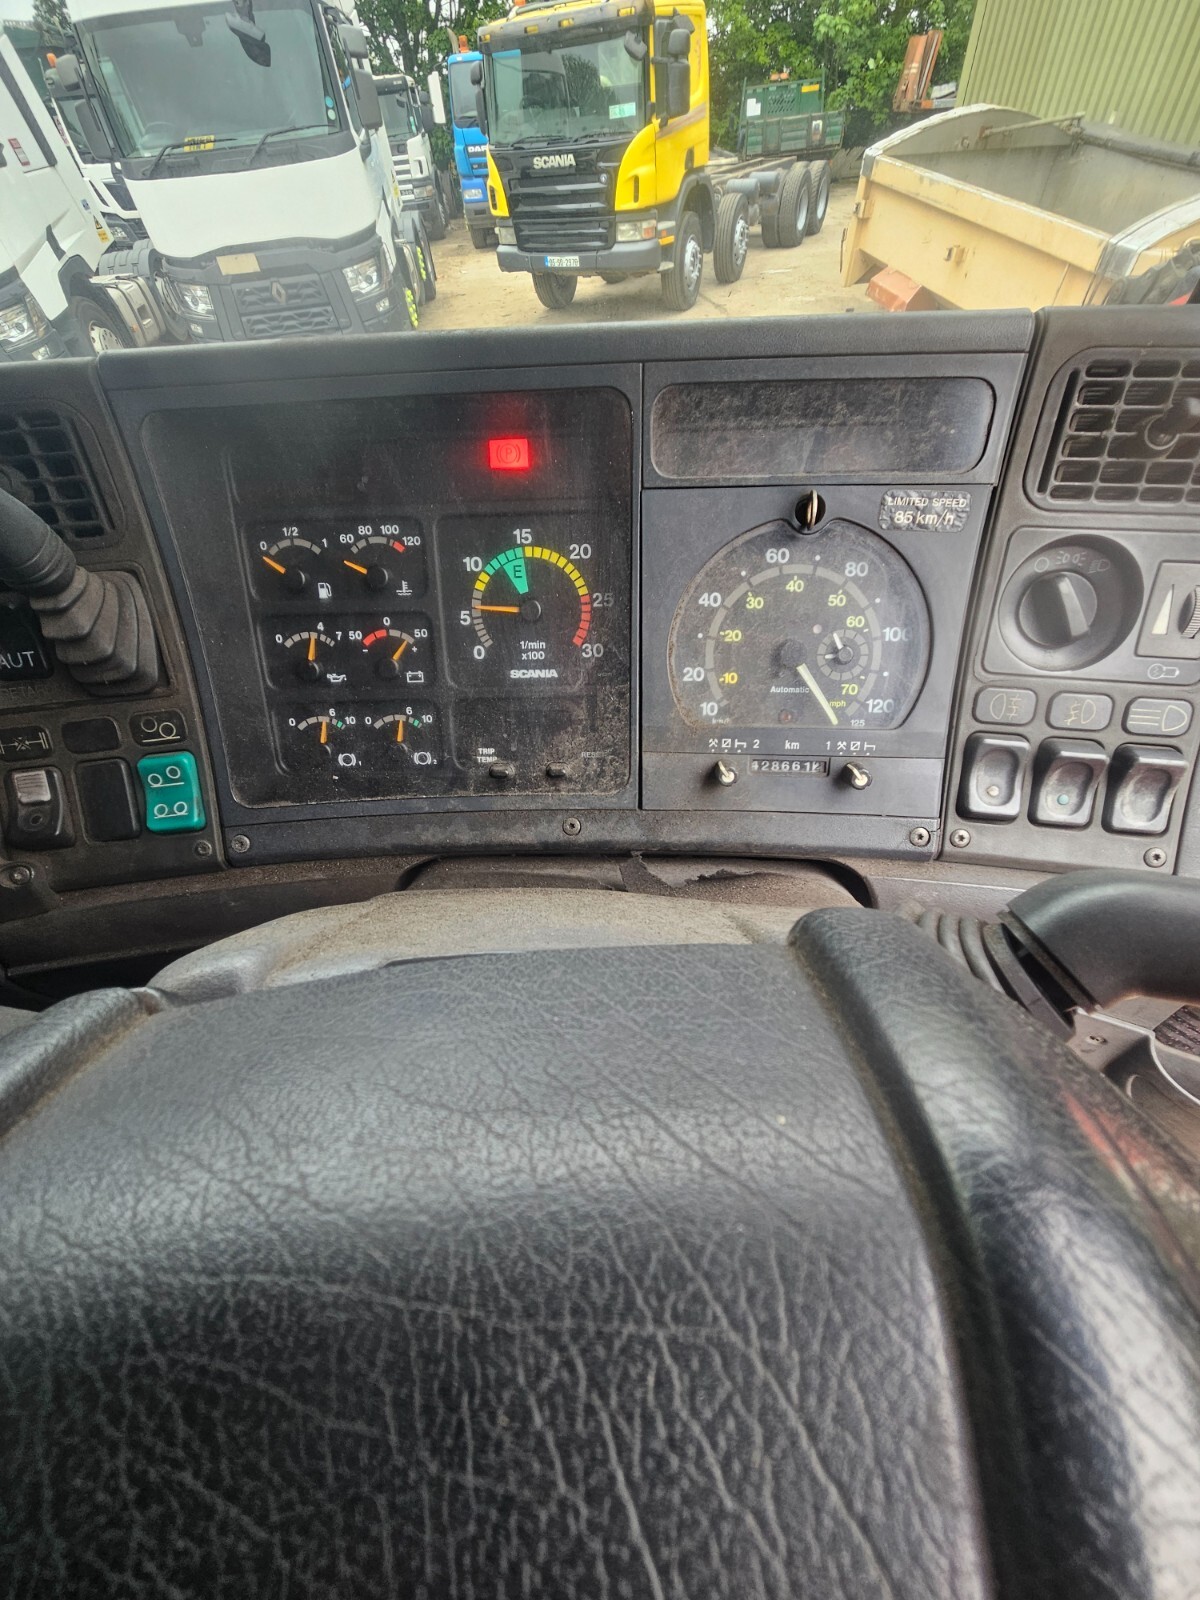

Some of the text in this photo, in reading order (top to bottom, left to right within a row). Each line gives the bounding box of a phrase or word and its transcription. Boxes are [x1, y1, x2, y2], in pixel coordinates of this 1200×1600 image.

[533, 153, 576, 169] SCANIA
[887, 497, 967, 508] LIMITED SPEED
[915, 509, 954, 527] km/h
[282, 526, 299, 537] 1/2
[358, 525, 372, 535] 80
[380, 524, 399, 535] 100
[339, 534, 354, 544] 60
[402, 536, 421, 546] 120
[513, 529, 532, 544] 15
[259, 541, 267, 551] 0
[322, 538, 328, 548] 1
[569, 544, 592, 559] 20
[766, 548, 790, 563] 60
[463, 557, 482, 572] 10
[845, 562, 868, 577] 80
[513, 565, 522, 579] E
[786, 580, 804, 592] 40
[592, 593, 614, 608] 25
[698, 592, 721, 607] 40
[746, 597, 764, 609] 30
[828, 594, 846, 607] 50
[383, 617, 391, 626] 0
[460, 611, 471, 626] 5
[846, 616, 865, 628] 60
[317, 622, 324, 631] 4
[276, 634, 283, 643] 0
[335, 632, 342, 641] 7
[349, 631, 362, 640] 50
[414, 628, 428, 638] 50
[723, 629, 742, 642] 20
[882, 627, 909, 642] 100
[520, 640, 546, 650] 1/min
[582, 643, 604, 658] 30
[473, 646, 485, 660] 0
[521, 651, 545, 661] x100
[0, 651, 35, 671] AUT
[510, 669, 558, 679] SCANIA
[683, 667, 705, 682] 20
[723, 672, 738, 684] 10
[770, 685, 810, 694] Automatic
[841, 683, 858, 696] 70
[700, 702, 718, 716] 10
[830, 700, 846, 709] mph
[866, 698, 893, 713] 120
[329, 708, 336, 717] 6
[406, 706, 413, 715] 6
[289, 717, 296, 726] 0
[345, 716, 356, 725] 10
[365, 716, 372, 725] 0
[422, 714, 433, 723] 10
[850, 719, 866, 727] 125
[753, 739, 760, 749] 2
[785, 739, 800, 750] km
[826, 741, 831, 750] 1
